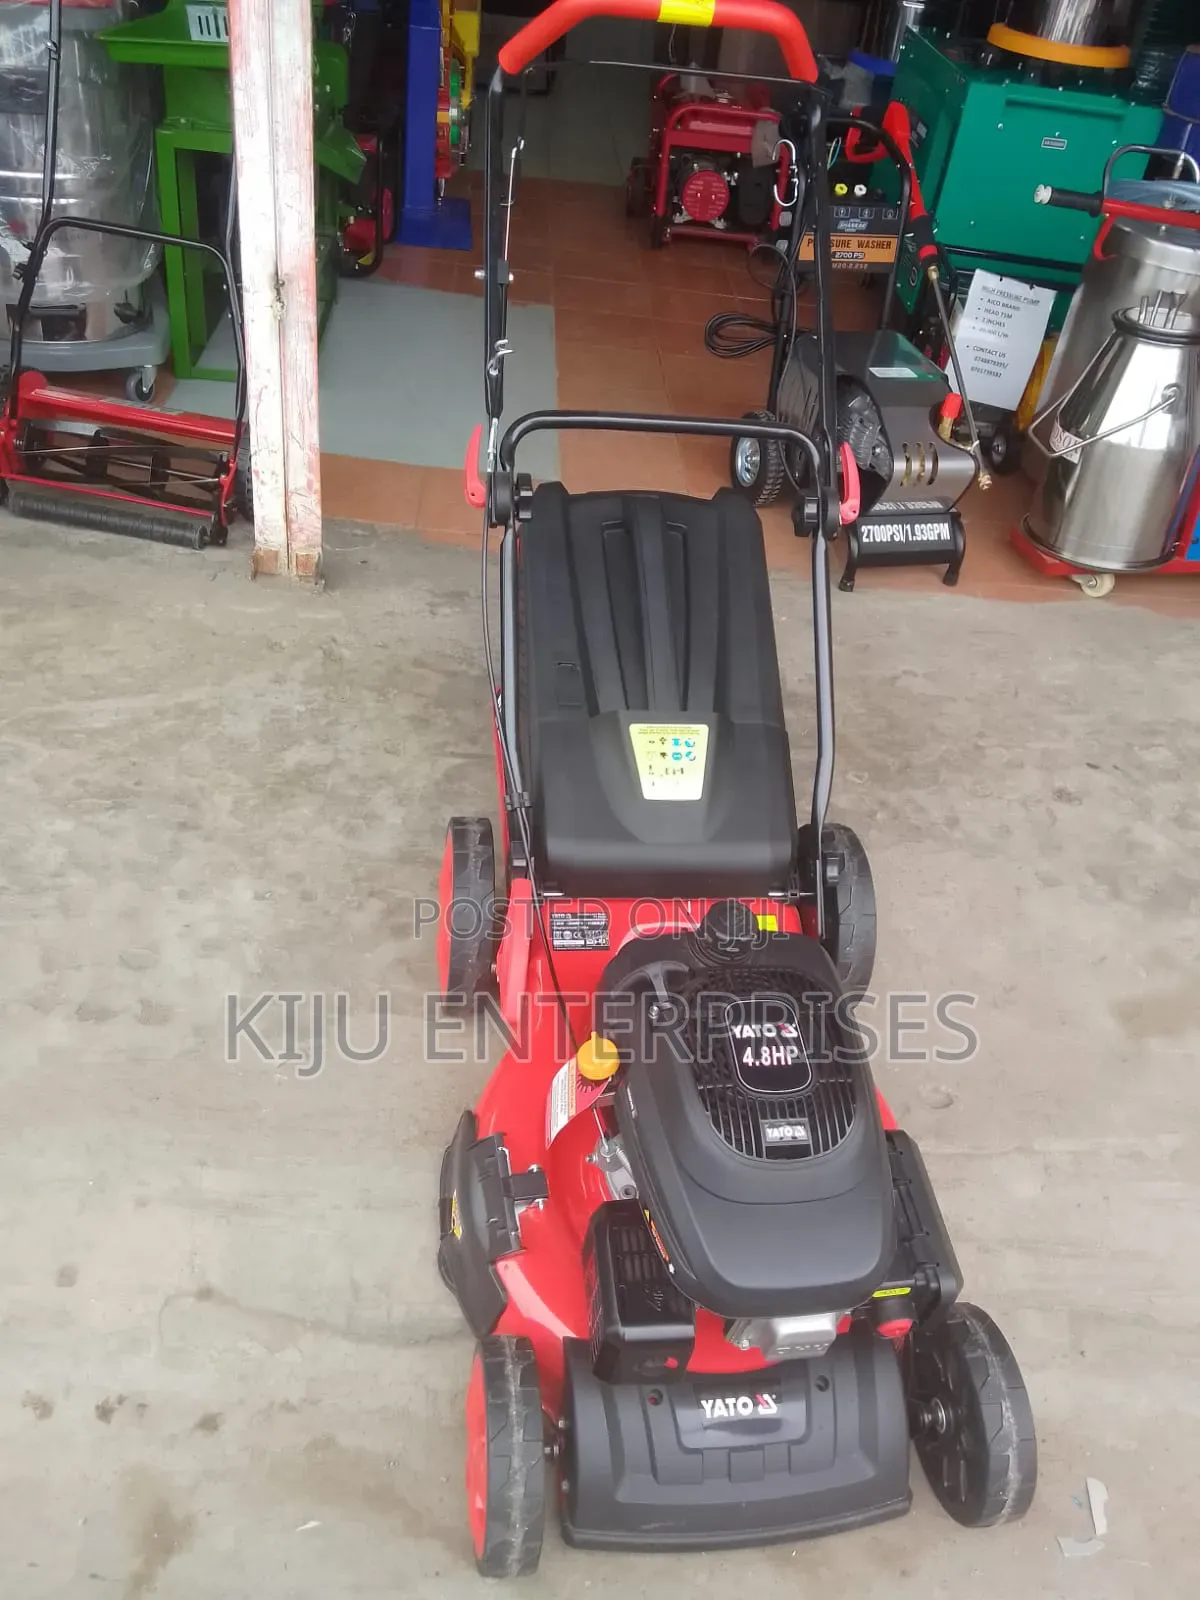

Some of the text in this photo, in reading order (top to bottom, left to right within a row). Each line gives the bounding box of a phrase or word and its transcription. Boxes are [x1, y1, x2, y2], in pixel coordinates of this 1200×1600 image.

[857, 240, 892, 250] WASHER
[834, 251, 853, 259] 2700
[973, 345, 998, 357] CONTACT
[861, 522, 951, 544] 2700PSI/1.93GPM
[732, 1023, 777, 1039] YATO
[742, 1045, 799, 1067] 4.8HP
[766, 1125, 793, 1138] YATO
[700, 1395, 754, 1419] YATO
